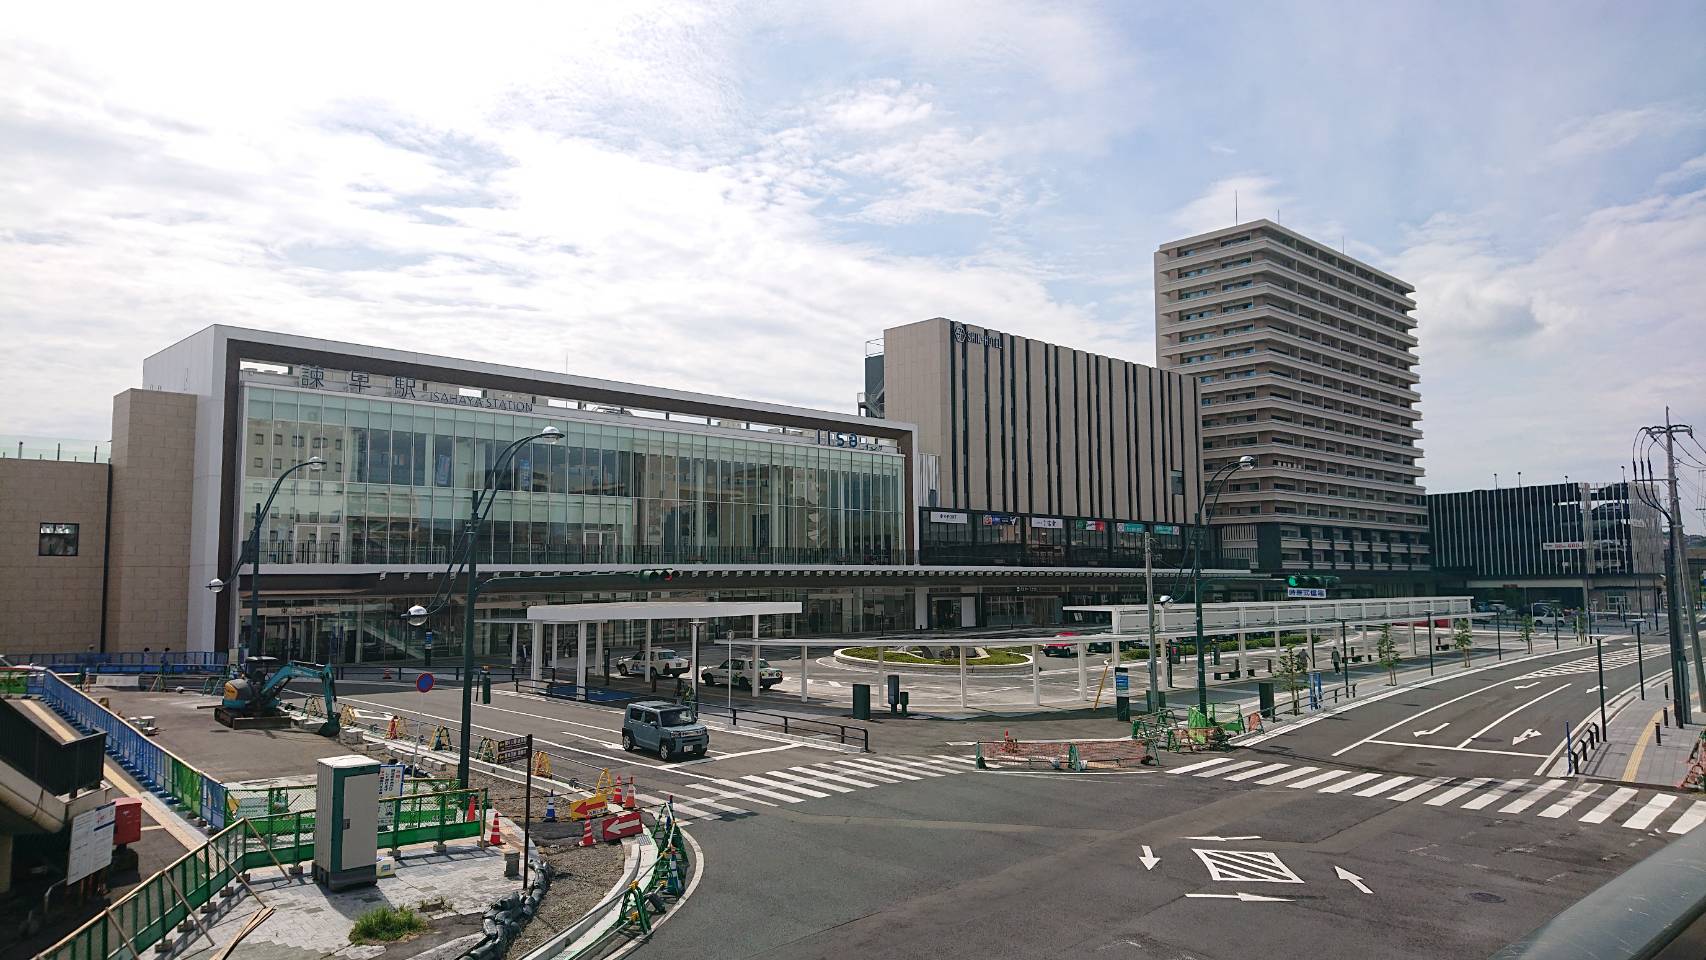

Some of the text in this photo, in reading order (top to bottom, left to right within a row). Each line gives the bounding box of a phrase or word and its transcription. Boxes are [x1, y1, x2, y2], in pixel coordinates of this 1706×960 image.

[301, 367, 416, 398] 諫早駅
[430, 391, 533, 412] ISAHAYA STATION
